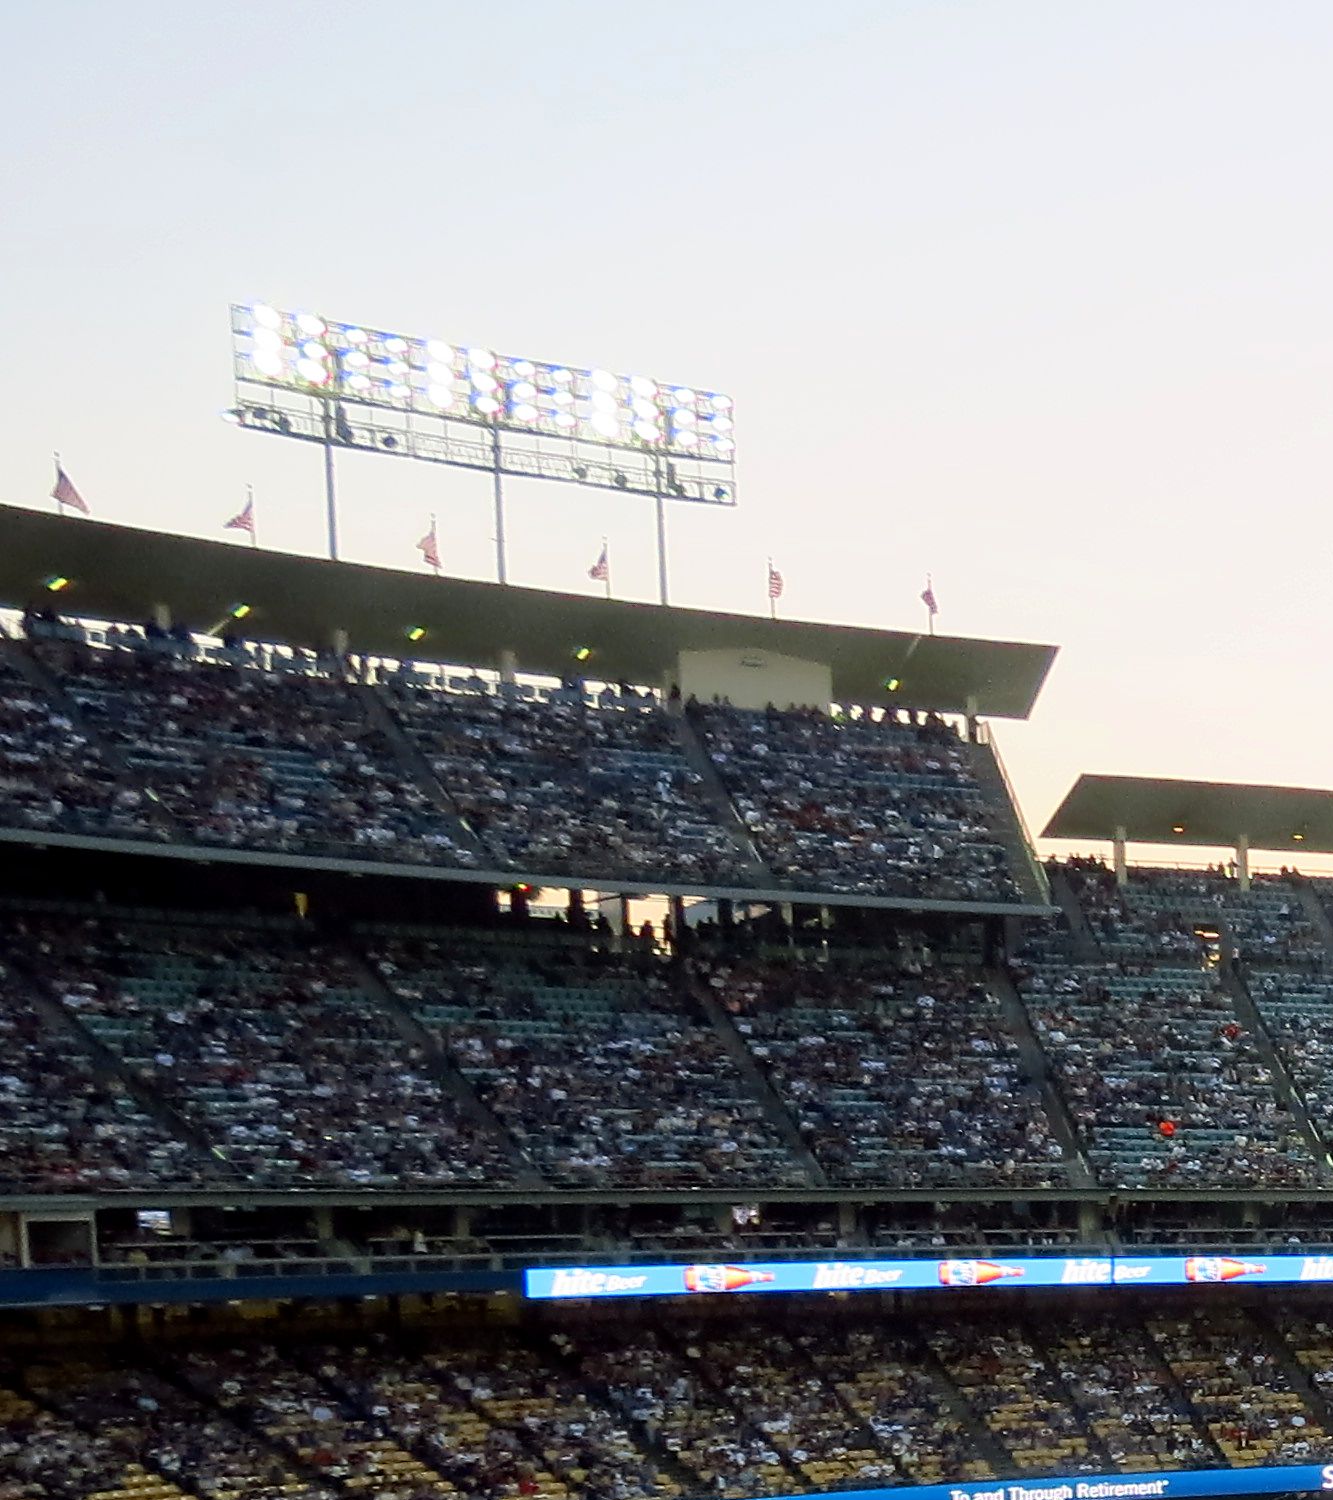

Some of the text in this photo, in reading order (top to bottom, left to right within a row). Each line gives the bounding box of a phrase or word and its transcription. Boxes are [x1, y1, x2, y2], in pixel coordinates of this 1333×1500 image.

[552, 1269, 605, 1296] hite
[813, 1263, 865, 1289] hite
[1061, 1260, 1112, 1284] hite
